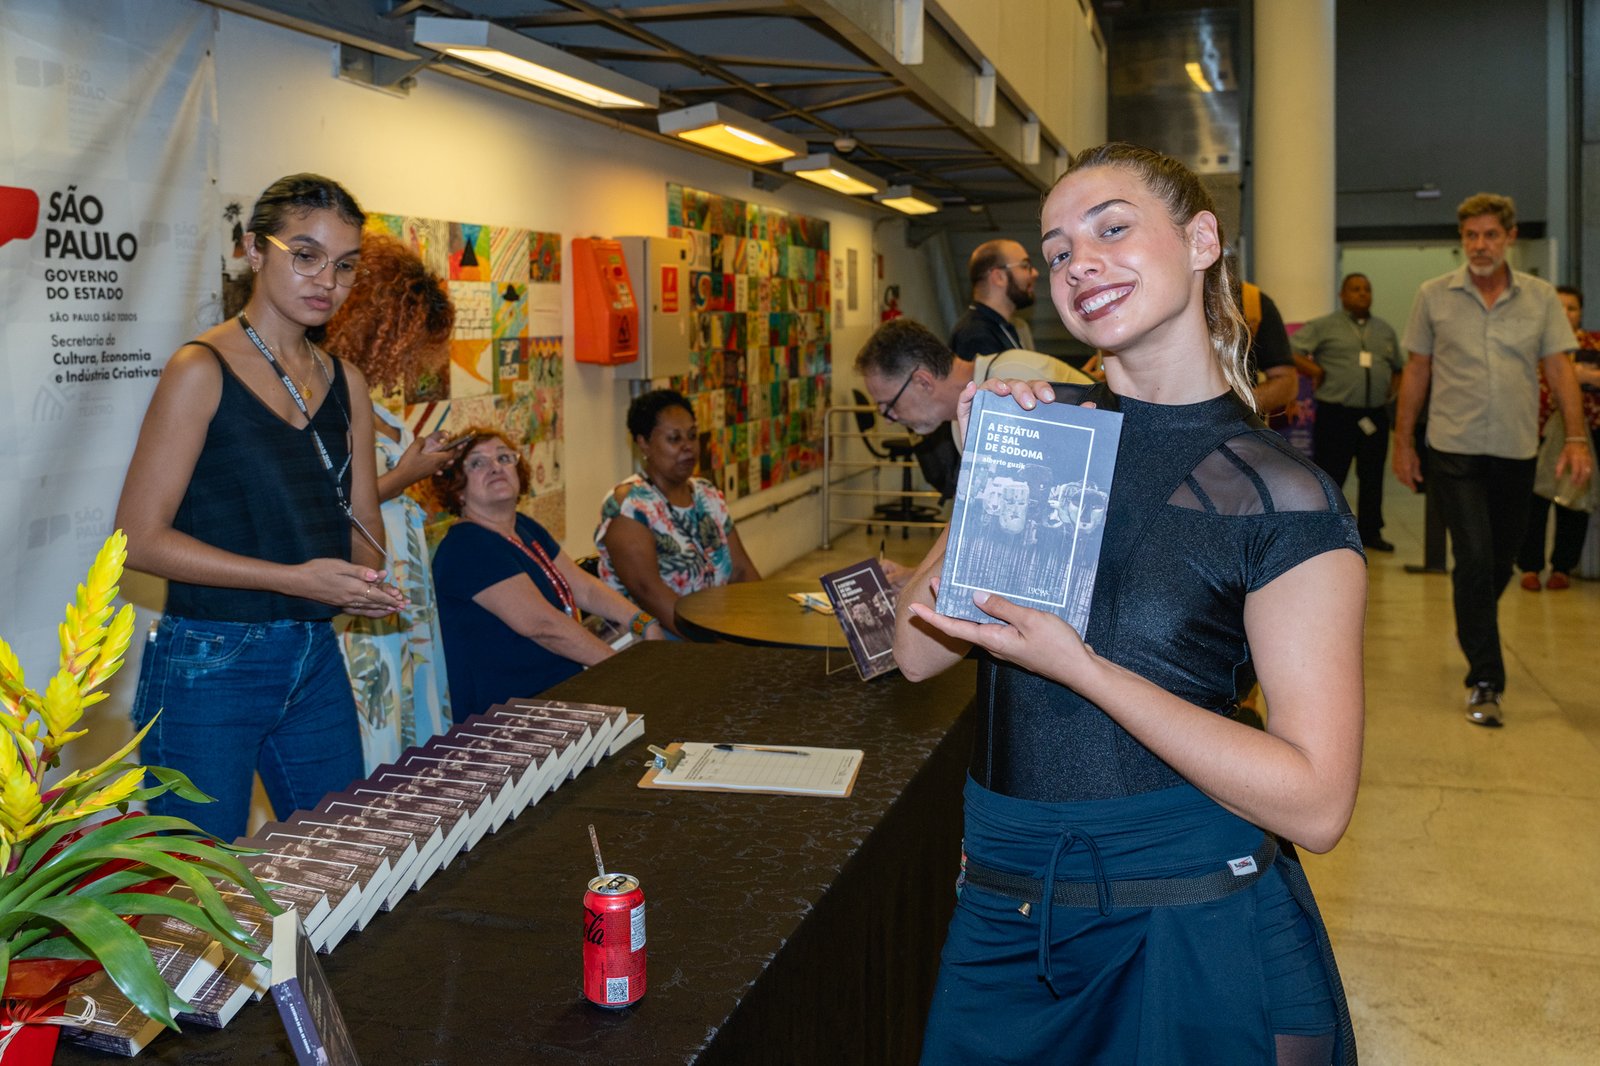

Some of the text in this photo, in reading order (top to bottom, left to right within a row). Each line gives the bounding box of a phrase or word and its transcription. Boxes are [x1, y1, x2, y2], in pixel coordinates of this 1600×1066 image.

[47, 185, 104, 226] SÃO
[44, 228, 139, 262] PAULO
[44, 268, 119, 284] GOVERNO
[46, 287, 124, 301] DO ESTADO
[73, 313, 100, 322] PAULO
[51, 333, 104, 347] Secretaria
[53, 349, 151, 366] Cultura, Economia
[55, 374, 63, 384] e
[66, 368, 110, 384] Indústria
[986, 432, 1020, 446] DE SAL
[988, 422, 1041, 440] A ESTÁTUA
[985, 442, 1044, 461] DE SODOMA
[982, 455, 1026, 471] alberto guzik
